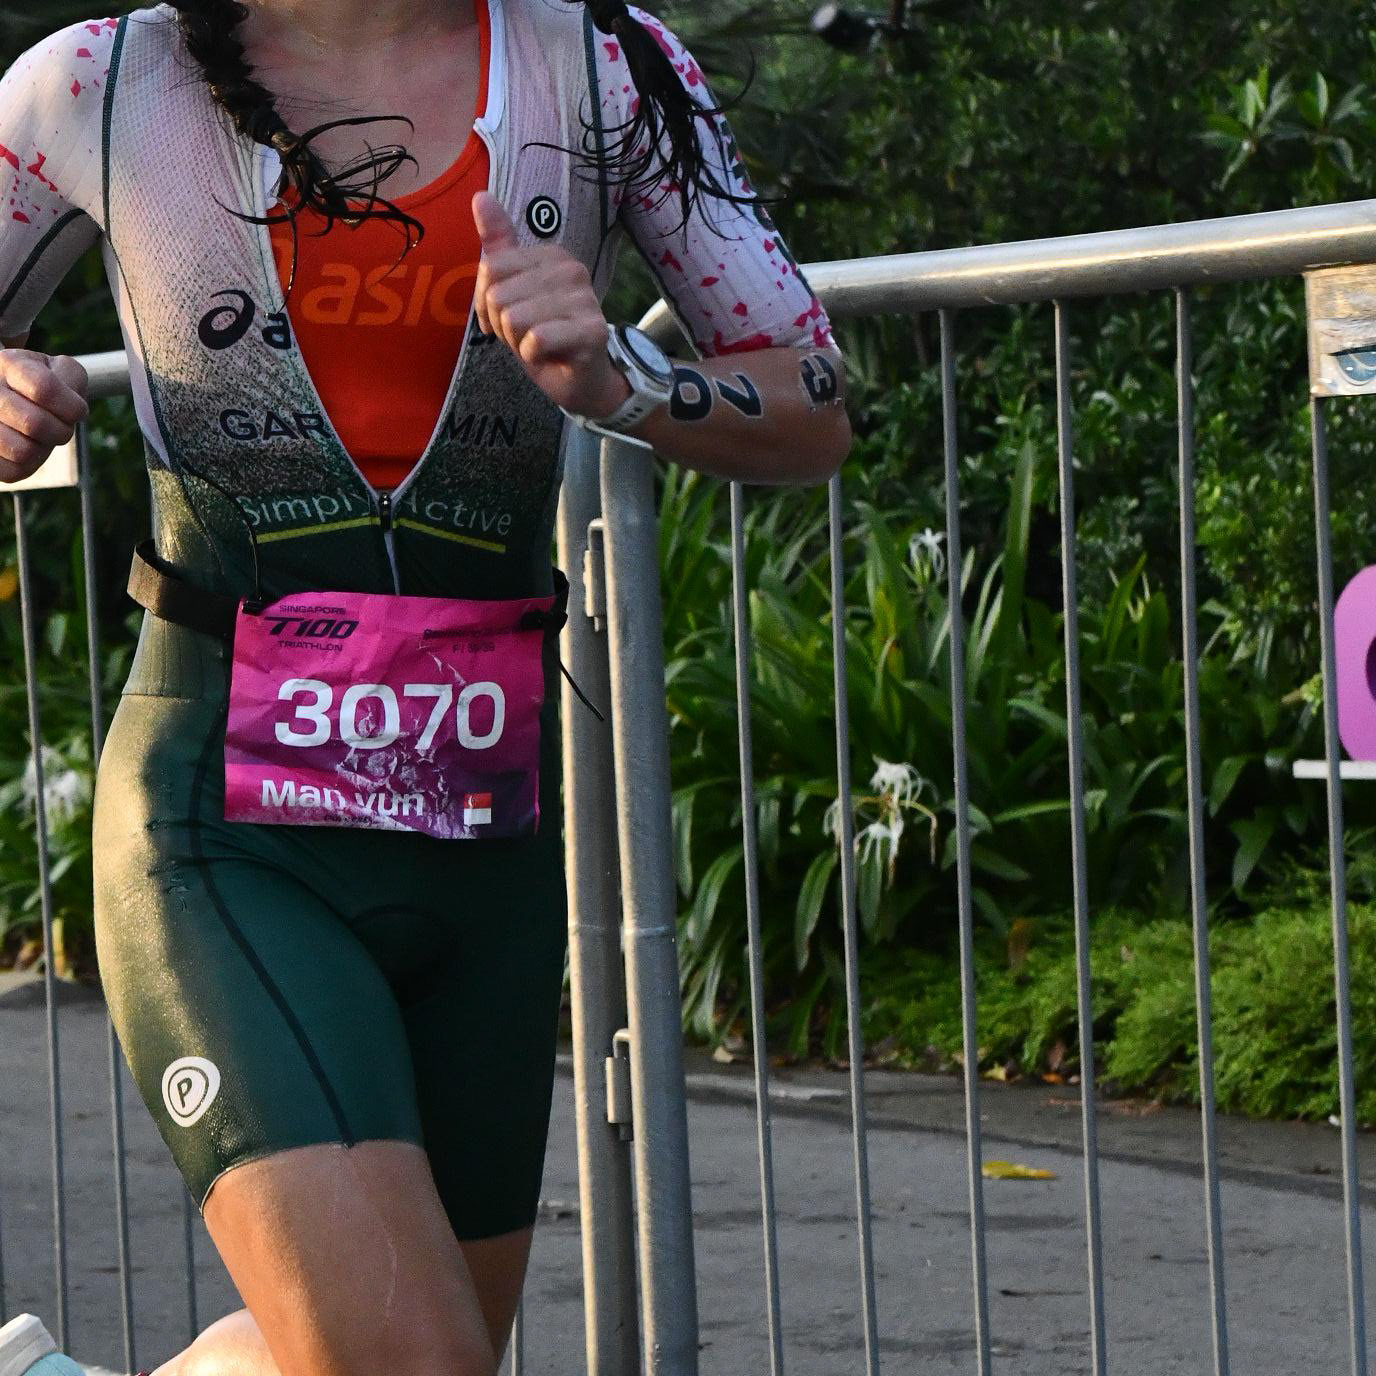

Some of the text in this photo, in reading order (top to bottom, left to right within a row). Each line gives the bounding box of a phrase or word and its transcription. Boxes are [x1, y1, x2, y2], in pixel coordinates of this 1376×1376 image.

[300, 263, 479, 325] asic
[279, 605, 347, 615] SINGAPORE
[264, 616, 360, 639] T100
[277, 640, 344, 652] TRIATHLON
[274, 678, 506, 750] 3070
[261, 779, 346, 810] Man
